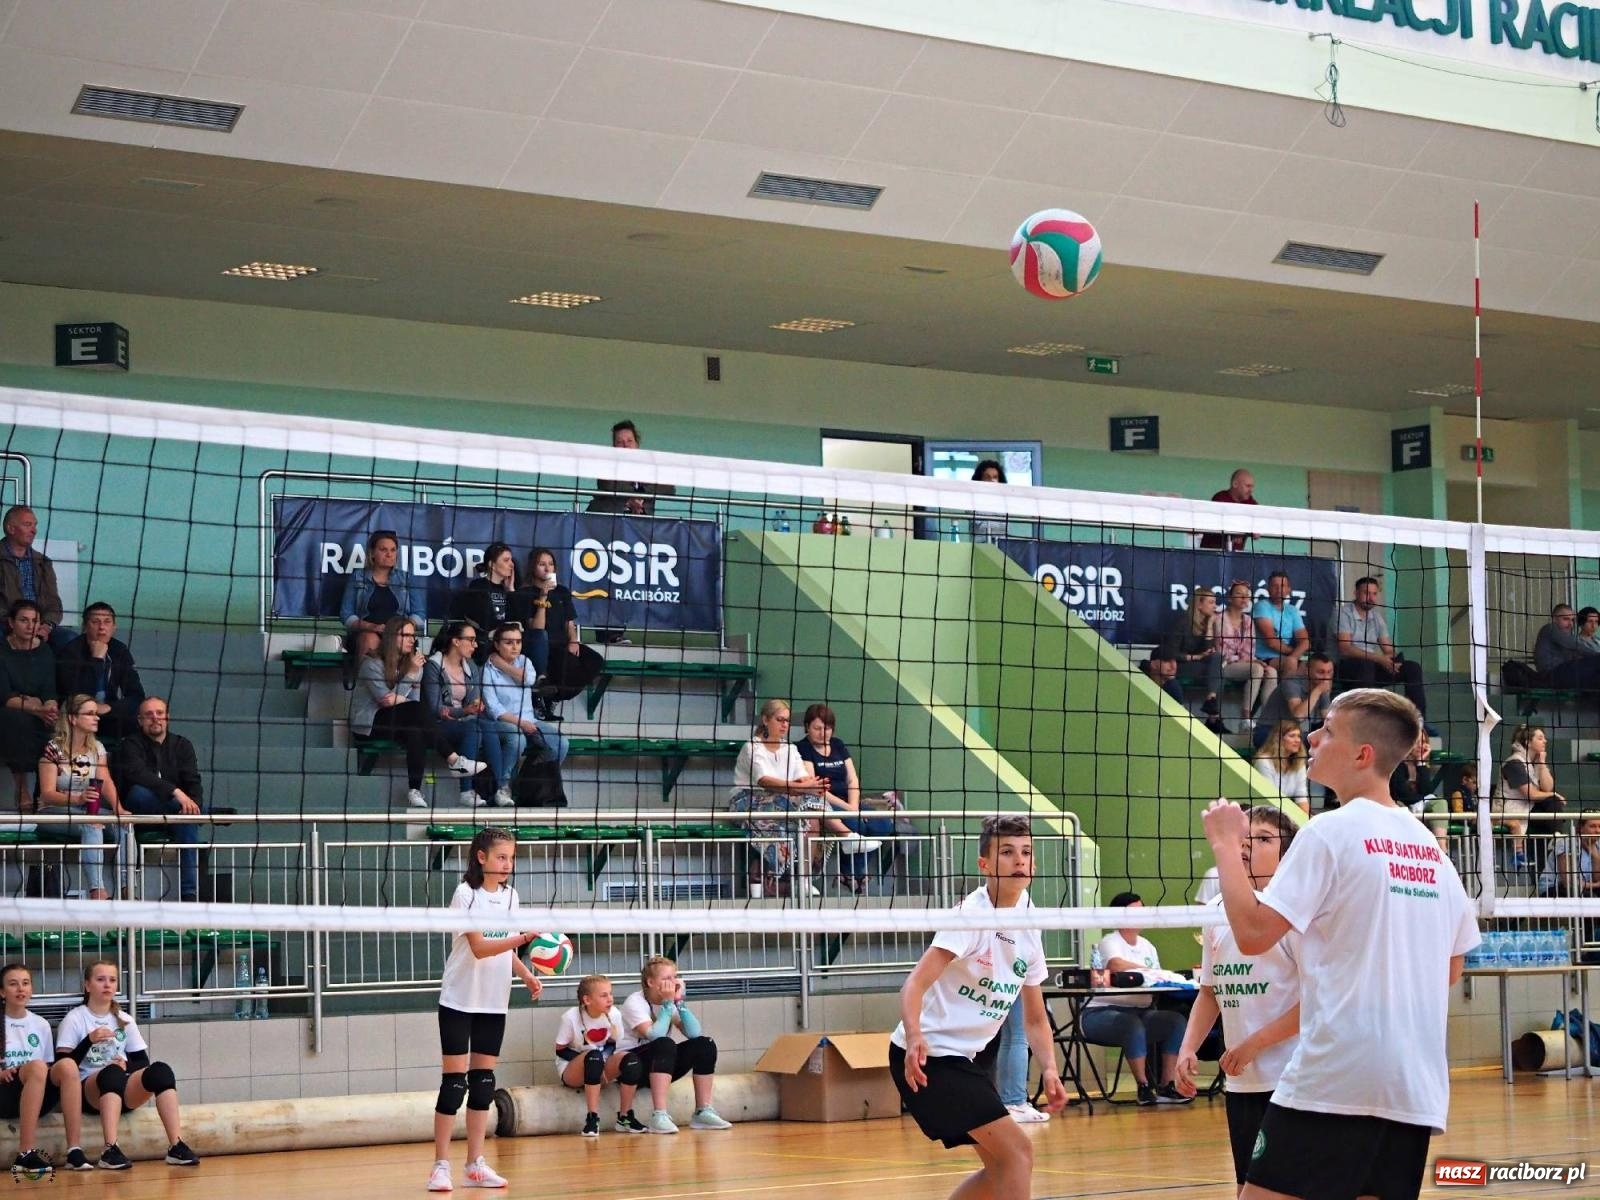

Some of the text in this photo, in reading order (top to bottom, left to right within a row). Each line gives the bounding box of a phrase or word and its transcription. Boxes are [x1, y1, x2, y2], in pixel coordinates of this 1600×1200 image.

[67, 326, 102, 335] SEKTOR
[71, 337, 98, 360] E
[117, 339, 127, 364] E
[1124, 428, 1146, 447] F
[1402, 441, 1422, 465] F
[615, 588, 680, 603] RACIBÓRZ
[1364, 838, 1394, 855] KLUB
[1389, 862, 1436, 884] RACIBÓRZ
[1213, 963, 1254, 976] GRAMY
[958, 985, 987, 1005] DLA
[1225, 982, 1270, 995] MAMY
